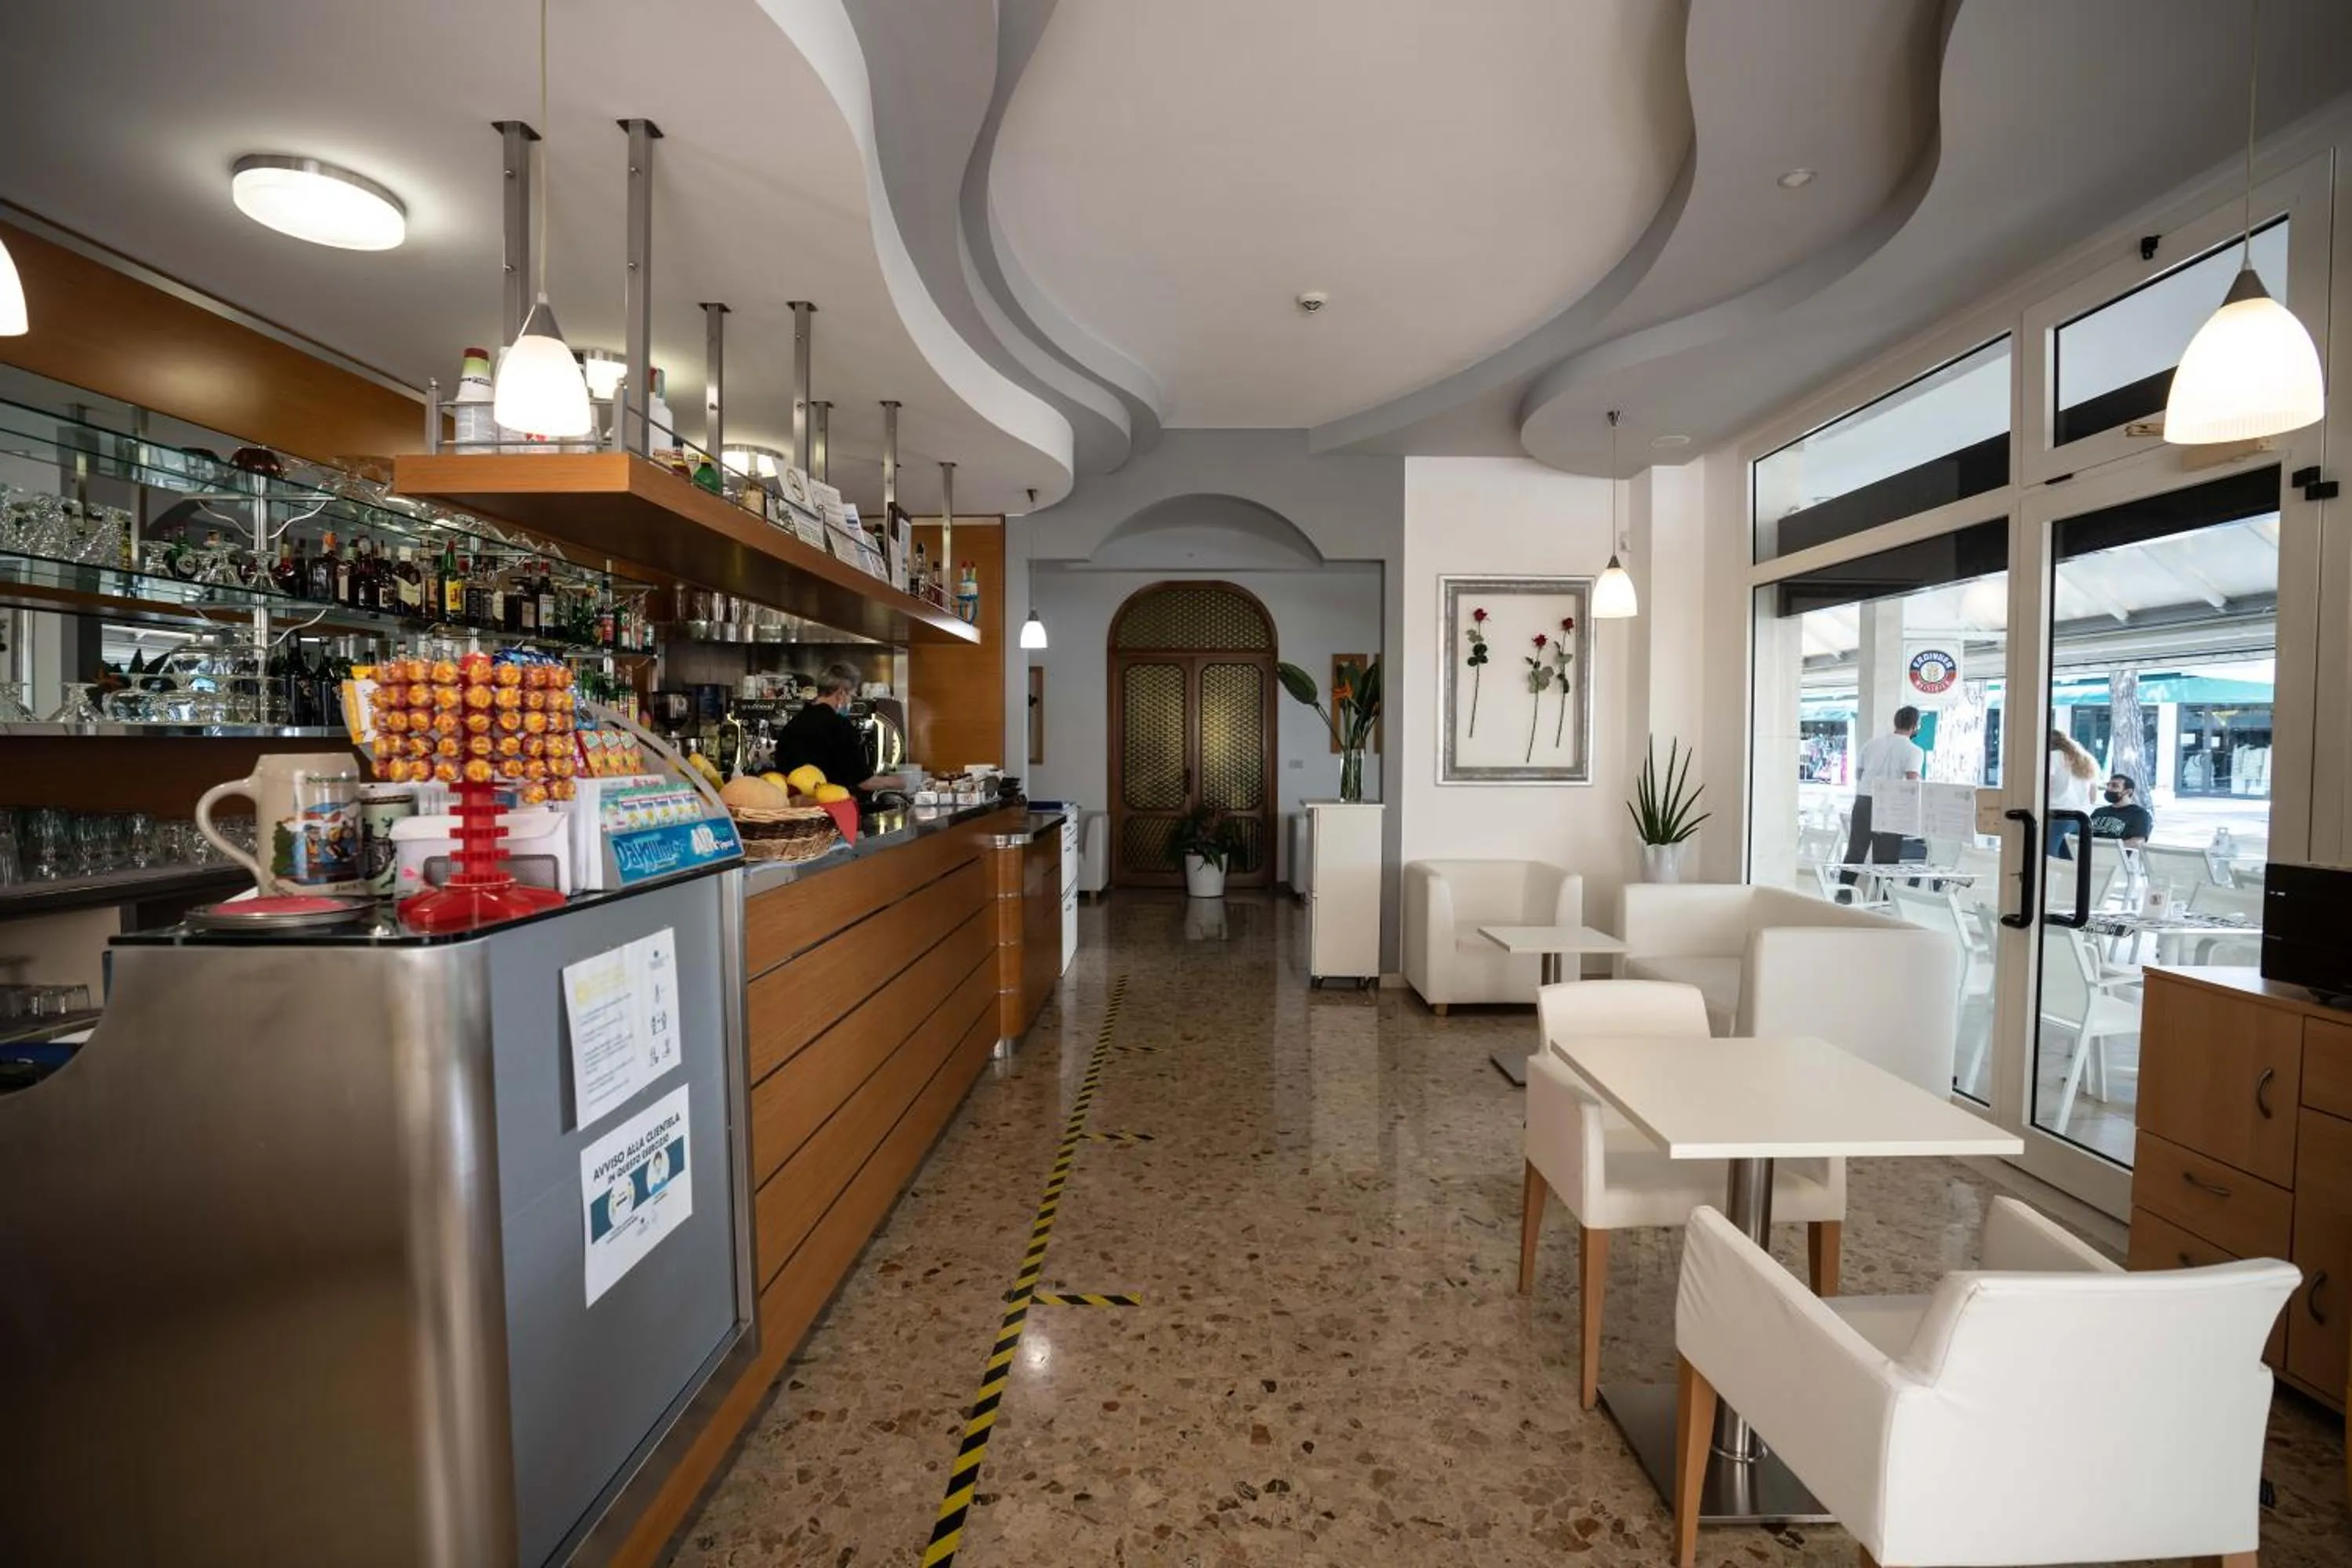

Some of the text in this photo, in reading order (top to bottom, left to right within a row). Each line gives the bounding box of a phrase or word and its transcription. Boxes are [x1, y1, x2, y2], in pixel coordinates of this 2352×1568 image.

[593, 1112, 681, 1181] AVVISO ALLA CLIENTELA
[608, 1175, 615, 1185] IN
[617, 1154, 641, 1178] QUESTO
